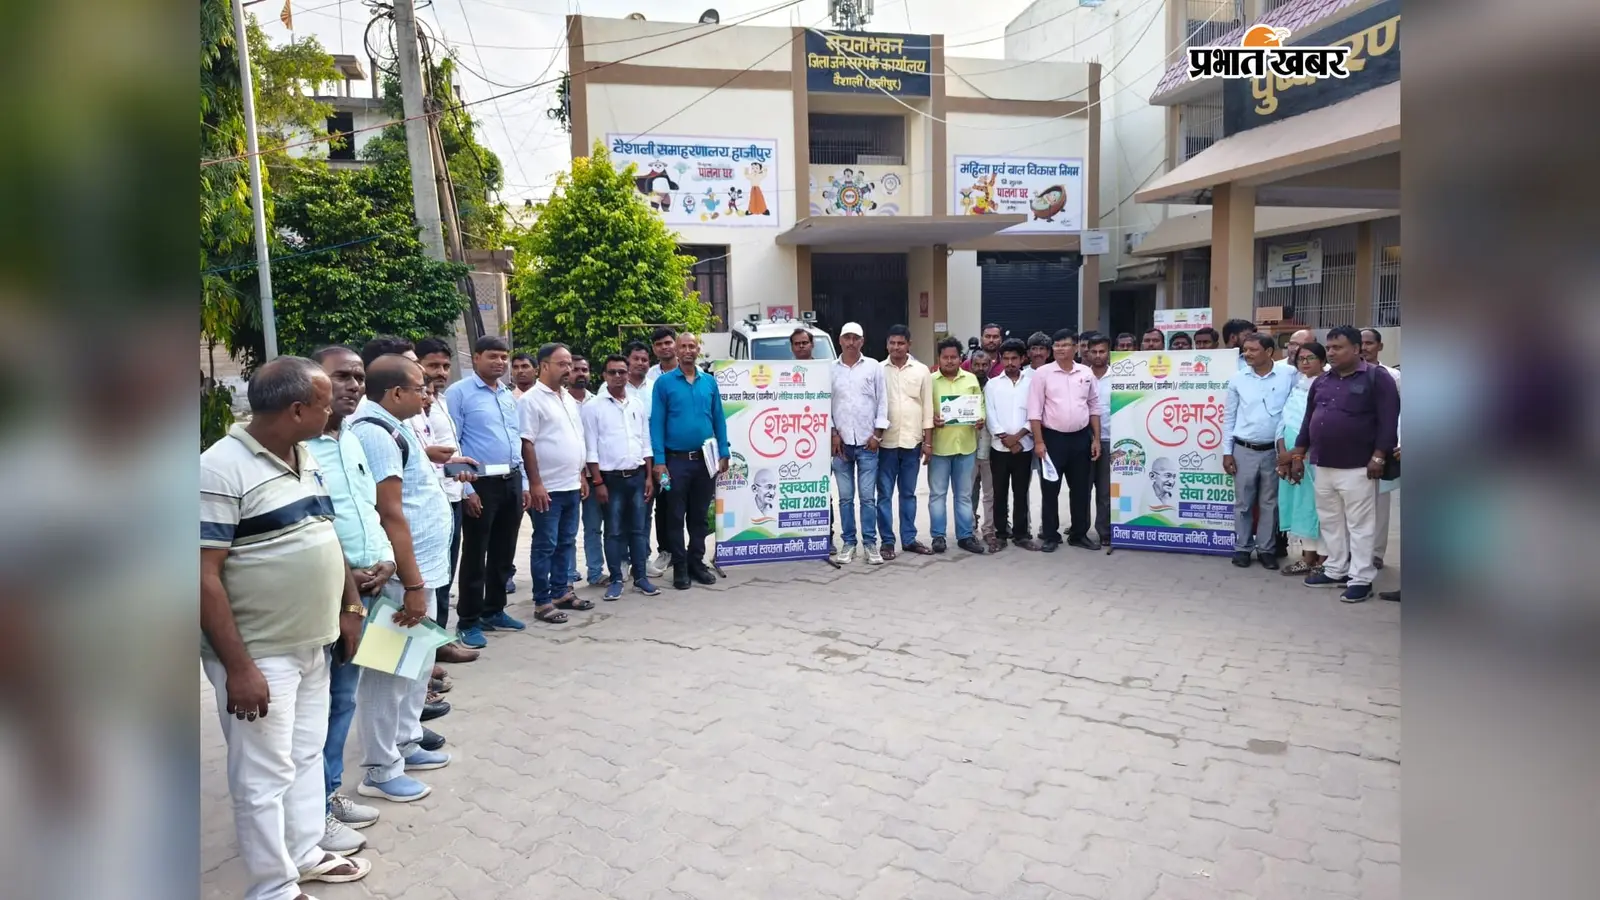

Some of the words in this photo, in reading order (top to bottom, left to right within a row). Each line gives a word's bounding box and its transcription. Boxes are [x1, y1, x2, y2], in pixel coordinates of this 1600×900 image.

[808, 53, 830, 69] जिला
[881, 56, 927, 73] कार्यालय
[833, 72, 864, 88] वैशाली
[612, 138, 655, 156] वैशाली
[656, 143, 730, 160] समाहरणालय
[731, 144, 773, 163] हाजीपुर
[697, 167, 721, 179] पालना
[722, 168, 734, 179] घर
[960, 160, 990, 179] महिला
[992, 161, 1006, 176] एवं
[1007, 164, 1026, 176] बाल
[1027, 162, 1058, 177] विकास
[1058, 163, 1080, 177] निगम
[996, 187, 1018, 199] पालना
[1019, 187, 1029, 199] घर
[1126, 382, 1138, 390] भारत
[1139, 380, 1153, 391] मिशन
[749, 405, 829, 460] शुभारंभ
[779, 480, 818, 494] स्वच्छता
[819, 475, 830, 494] ही
[1179, 471, 1223, 486] स्वच्छता
[1225, 473, 1234, 487] ह
[779, 494, 801, 510] सेवा
[802, 496, 827, 509] 2026
[1179, 484, 1204, 500] सेवा
[1206, 488, 1234, 502] 2026
[1113, 526, 1130, 539] जिला
[1131, 530, 1145, 540] जल
[1146, 529, 1157, 541] एवं
[1158, 531, 1184, 543] स्वच्छता
[1212, 531, 1236, 546] वैशाली
[716, 543, 733, 557] जिला
[734, 546, 747, 556] जल
[748, 543, 758, 555] एवं
[759, 544, 783, 555] स्वच्छता
[807, 537, 828, 551] वैशाली
